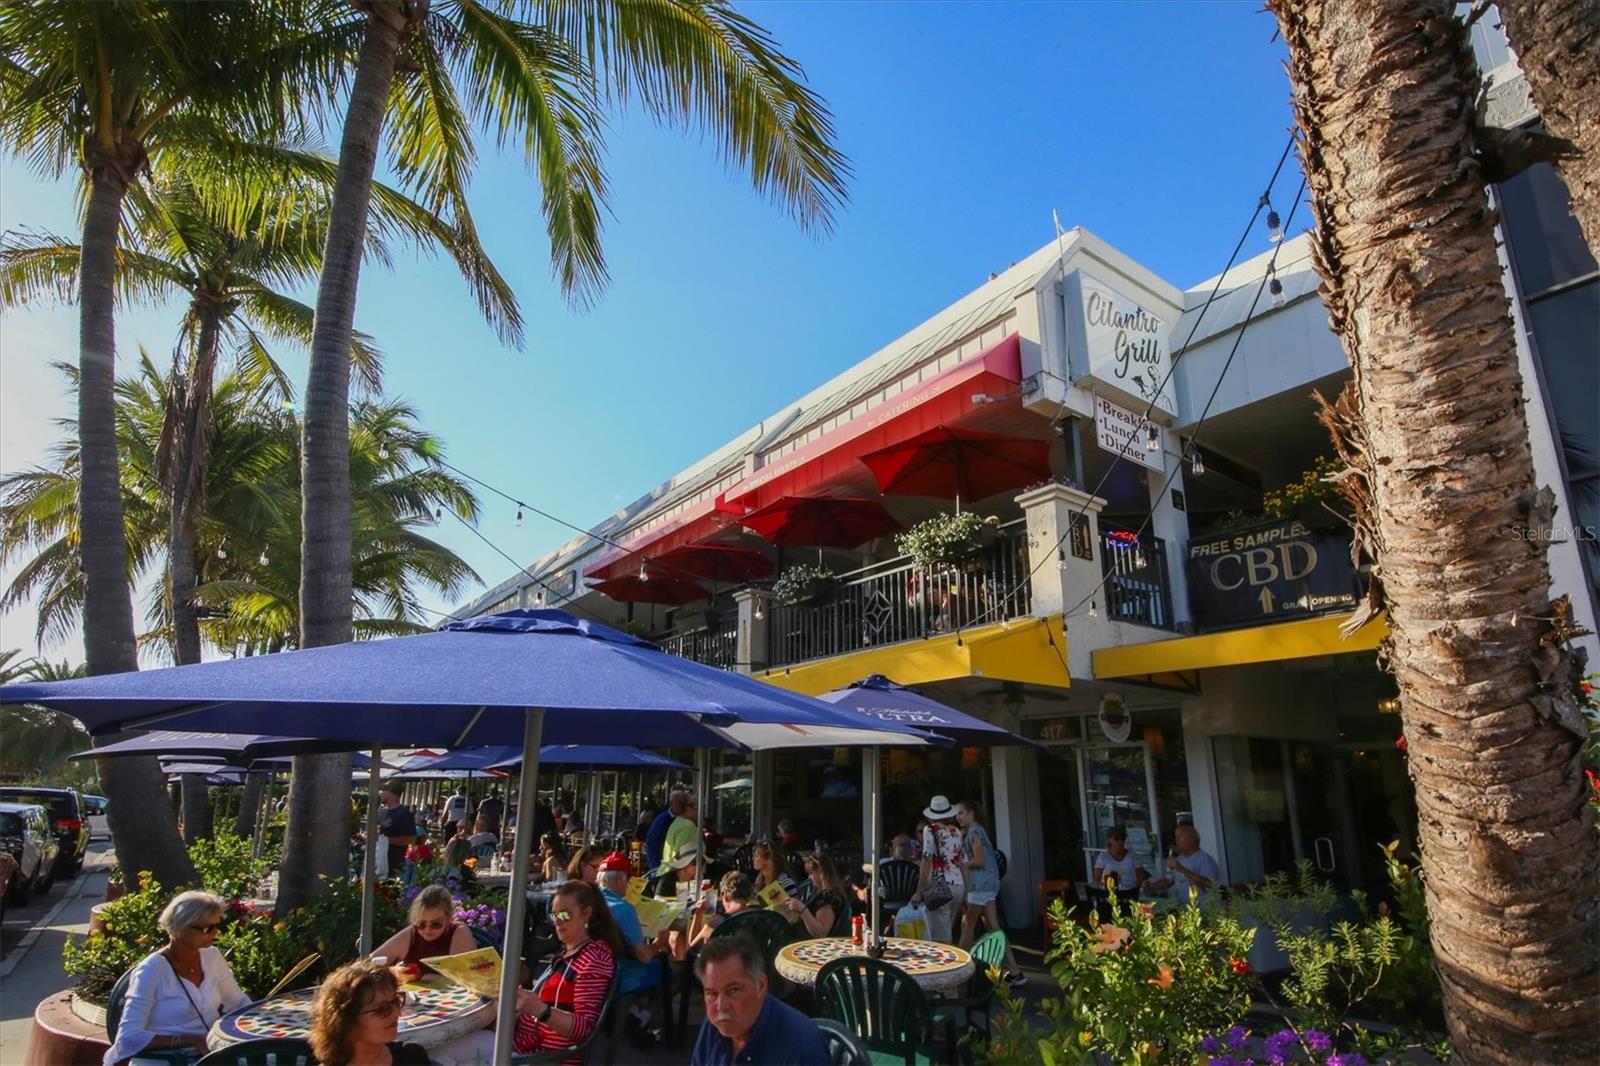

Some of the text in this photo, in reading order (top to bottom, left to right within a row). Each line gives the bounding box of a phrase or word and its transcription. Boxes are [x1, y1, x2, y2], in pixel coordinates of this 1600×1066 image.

[1087, 291, 1160, 333] Cilantro
[1114, 330, 1161, 378] Grill
[879, 391, 929, 422] CATERING
[1104, 417, 1140, 444] Lunch
[1105, 434, 1146, 461] Dinner
[1191, 540, 1230, 558] FREE
[1210, 540, 1318, 591] CBD
[1311, 593, 1353, 607] OPENING
[1040, 725, 1064, 740] 417
